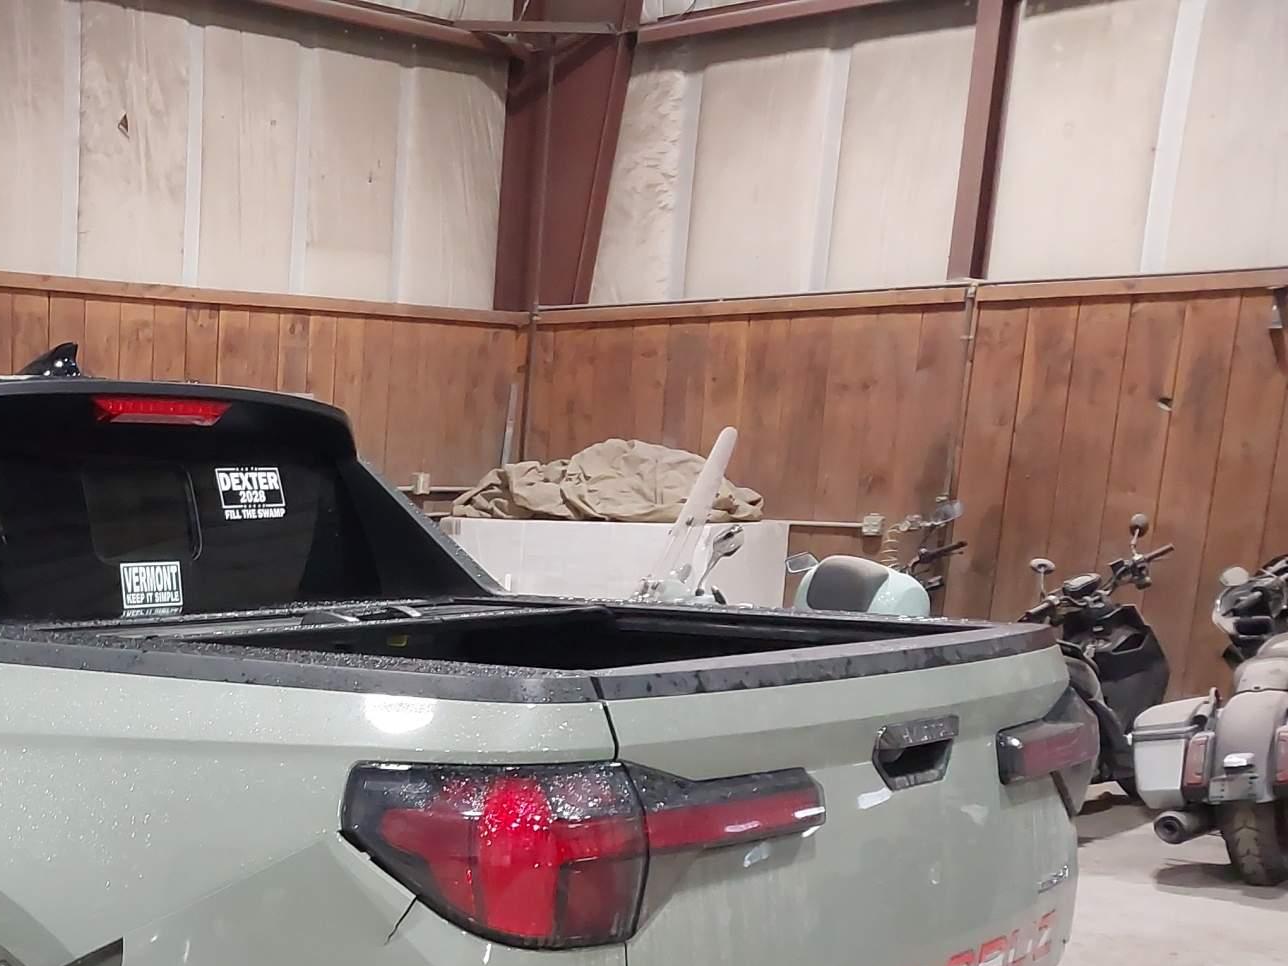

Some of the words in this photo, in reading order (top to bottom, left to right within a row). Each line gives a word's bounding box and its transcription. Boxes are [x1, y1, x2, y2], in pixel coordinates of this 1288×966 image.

[218, 472, 279, 491] DEXTER
[239, 490, 266, 503] 2028
[225, 509, 242, 520] FILL
[241, 509, 257, 519] THE
[257, 508, 285, 519] SWAMP
[123, 565, 177, 593] VERMONT
[126, 593, 145, 604] KEEP
[146, 592, 153, 603] IT
[154, 591, 180, 602] SIMPLE
